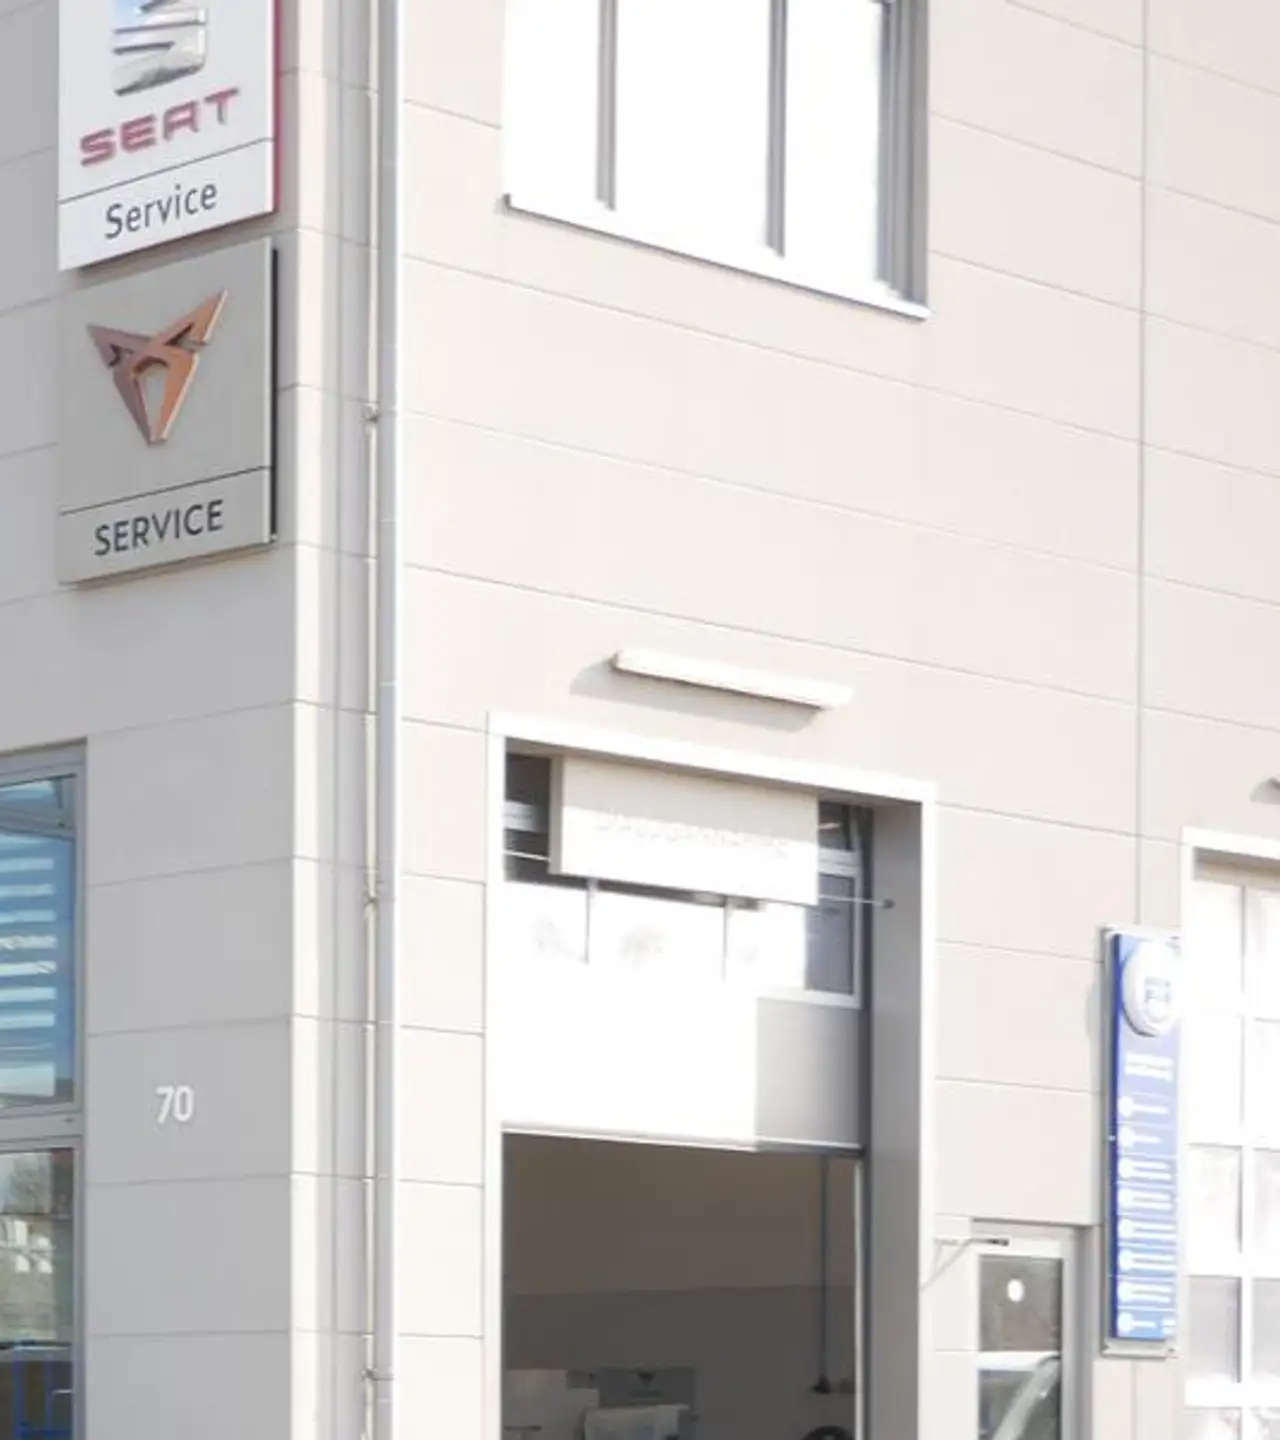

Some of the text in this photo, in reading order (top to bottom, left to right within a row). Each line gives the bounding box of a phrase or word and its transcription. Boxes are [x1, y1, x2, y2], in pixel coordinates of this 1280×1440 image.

[79, 86, 239, 168] SEAT
[104, 183, 218, 240] Service
[93, 498, 224, 557] SERVICE
[154, 1084, 195, 1124] 70
